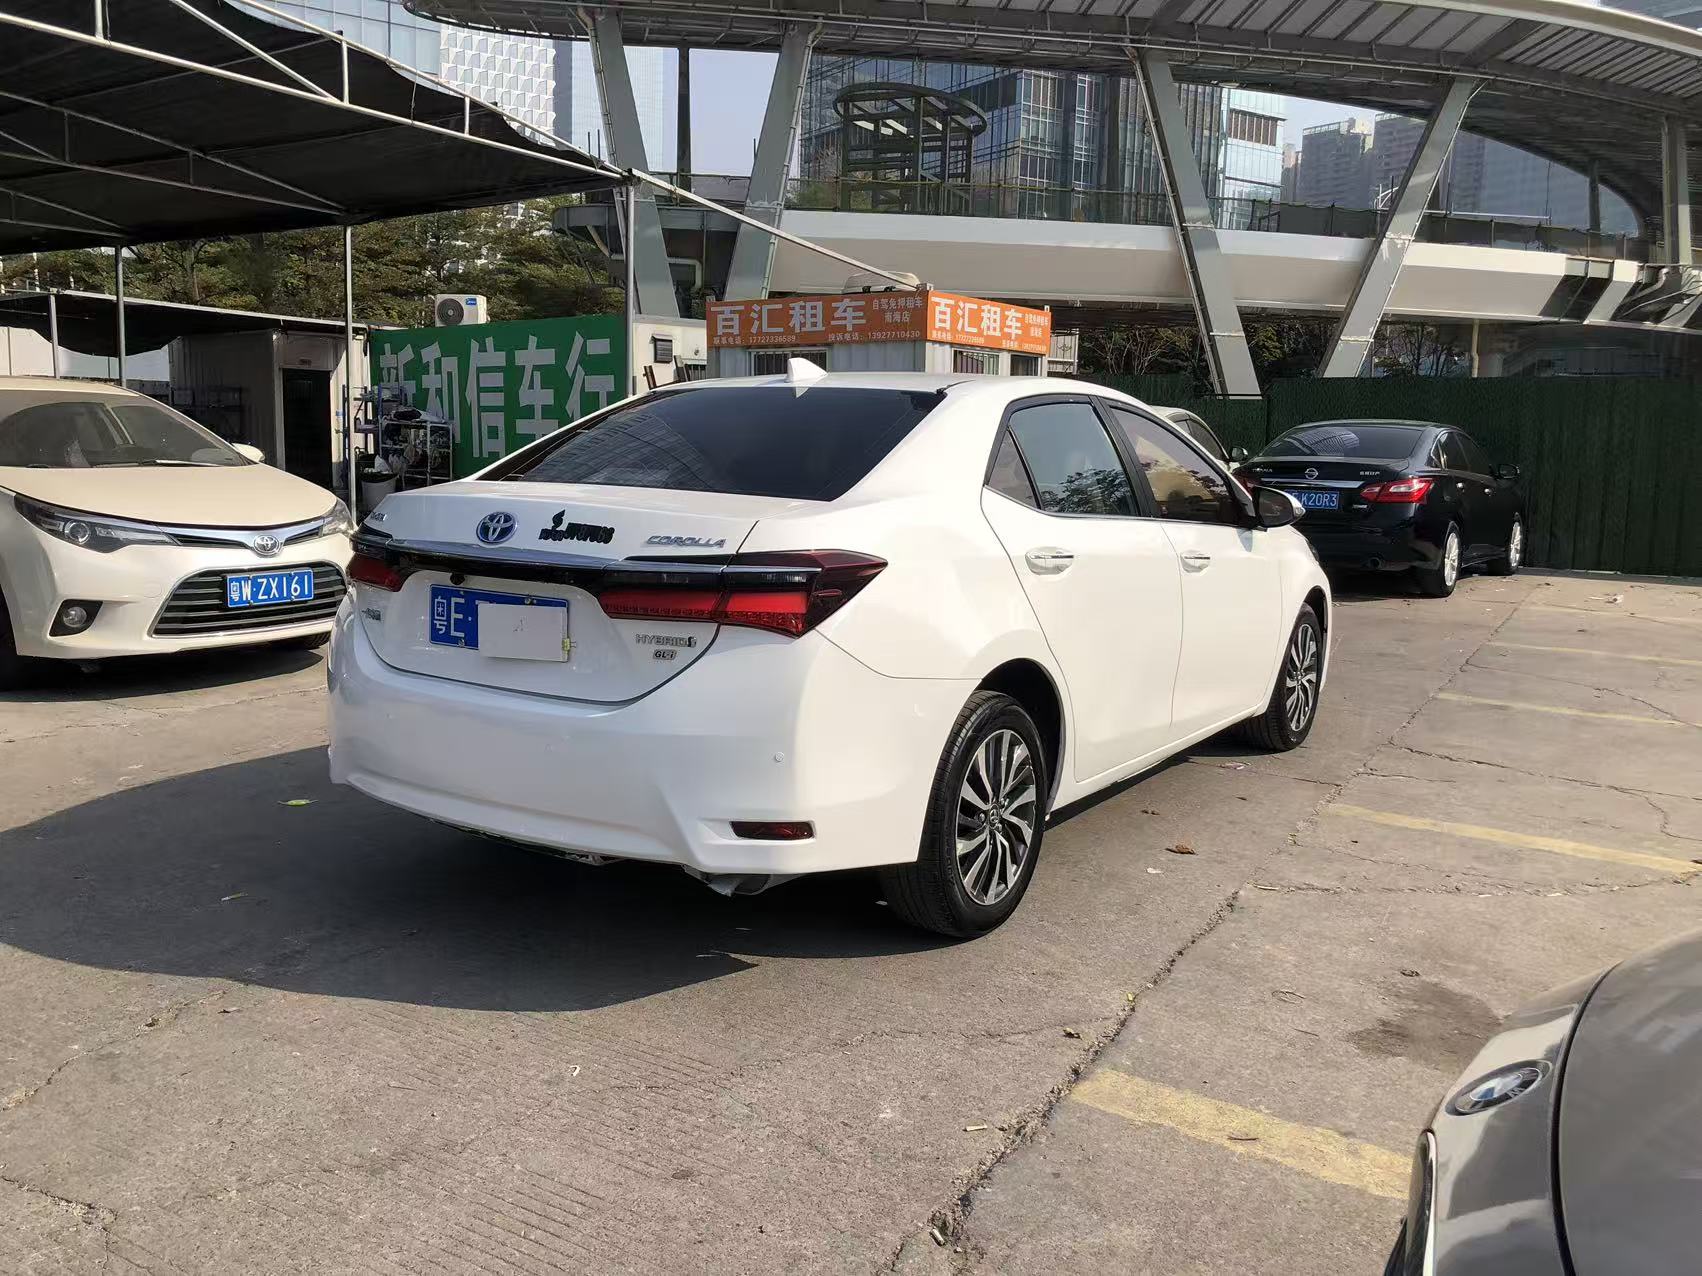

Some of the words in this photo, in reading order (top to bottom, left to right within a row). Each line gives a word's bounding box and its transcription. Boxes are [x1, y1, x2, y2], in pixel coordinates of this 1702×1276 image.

[711, 299, 866, 335] 百汇租车
[931, 296, 1022, 340] 百汇租车
[868, 330, 920, 340] 13927710430
[380, 331, 615, 458] 新和信车行
[646, 535, 726, 548] COROLLA
[635, 633, 688, 647] HYBRID
